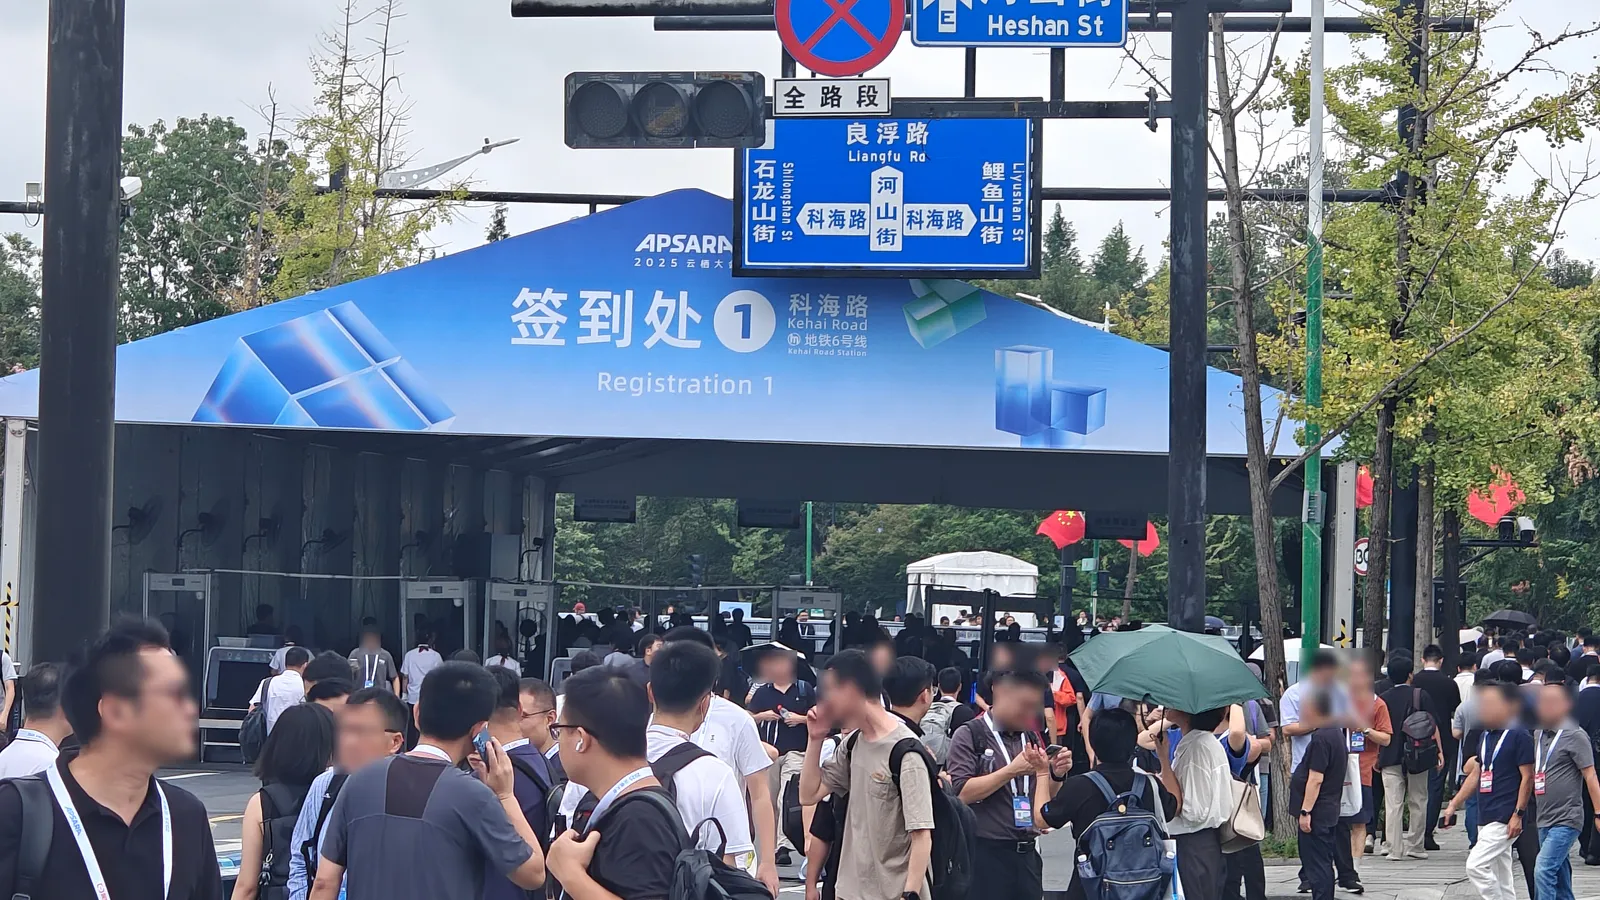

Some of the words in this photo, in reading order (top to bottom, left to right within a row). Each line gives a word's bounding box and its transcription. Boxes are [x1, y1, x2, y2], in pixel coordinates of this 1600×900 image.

[940, 10, 955, 25] E
[988, 14, 1069, 36] Heshan
[1077, 15, 1104, 36] St
[783, 84, 879, 109] 全路段
[846, 121, 929, 145] 良浮路
[848, 150, 901, 165] Liangfu
[751, 159, 777, 243] 石龙山街
[780, 162, 794, 224] Shilongshan
[1010, 162, 1025, 221] Liyushan
[876, 176, 898, 246] 河山街
[980, 161, 1005, 245] 鲤鱼山街
[806, 208, 867, 230] 科海路
[906, 209, 965, 231] 科海路
[634, 233, 733, 254] APSARA
[781, 230, 793, 241] St
[1012, 228, 1024, 242] St
[634, 257, 678, 268] 2025
[789, 292, 868, 319] 科海路
[510, 286, 702, 350] 签到处
[732, 303, 752, 340] 1
[787, 317, 827, 330] Kehai
[832, 319, 868, 331] Road
[804, 332, 867, 349] 地铁6号线
[787, 347, 811, 355] Kehai
[813, 347, 835, 356] Road
[837, 348, 867, 357] Station
[597, 371, 753, 399] Registration
[762, 376, 774, 396] 1
